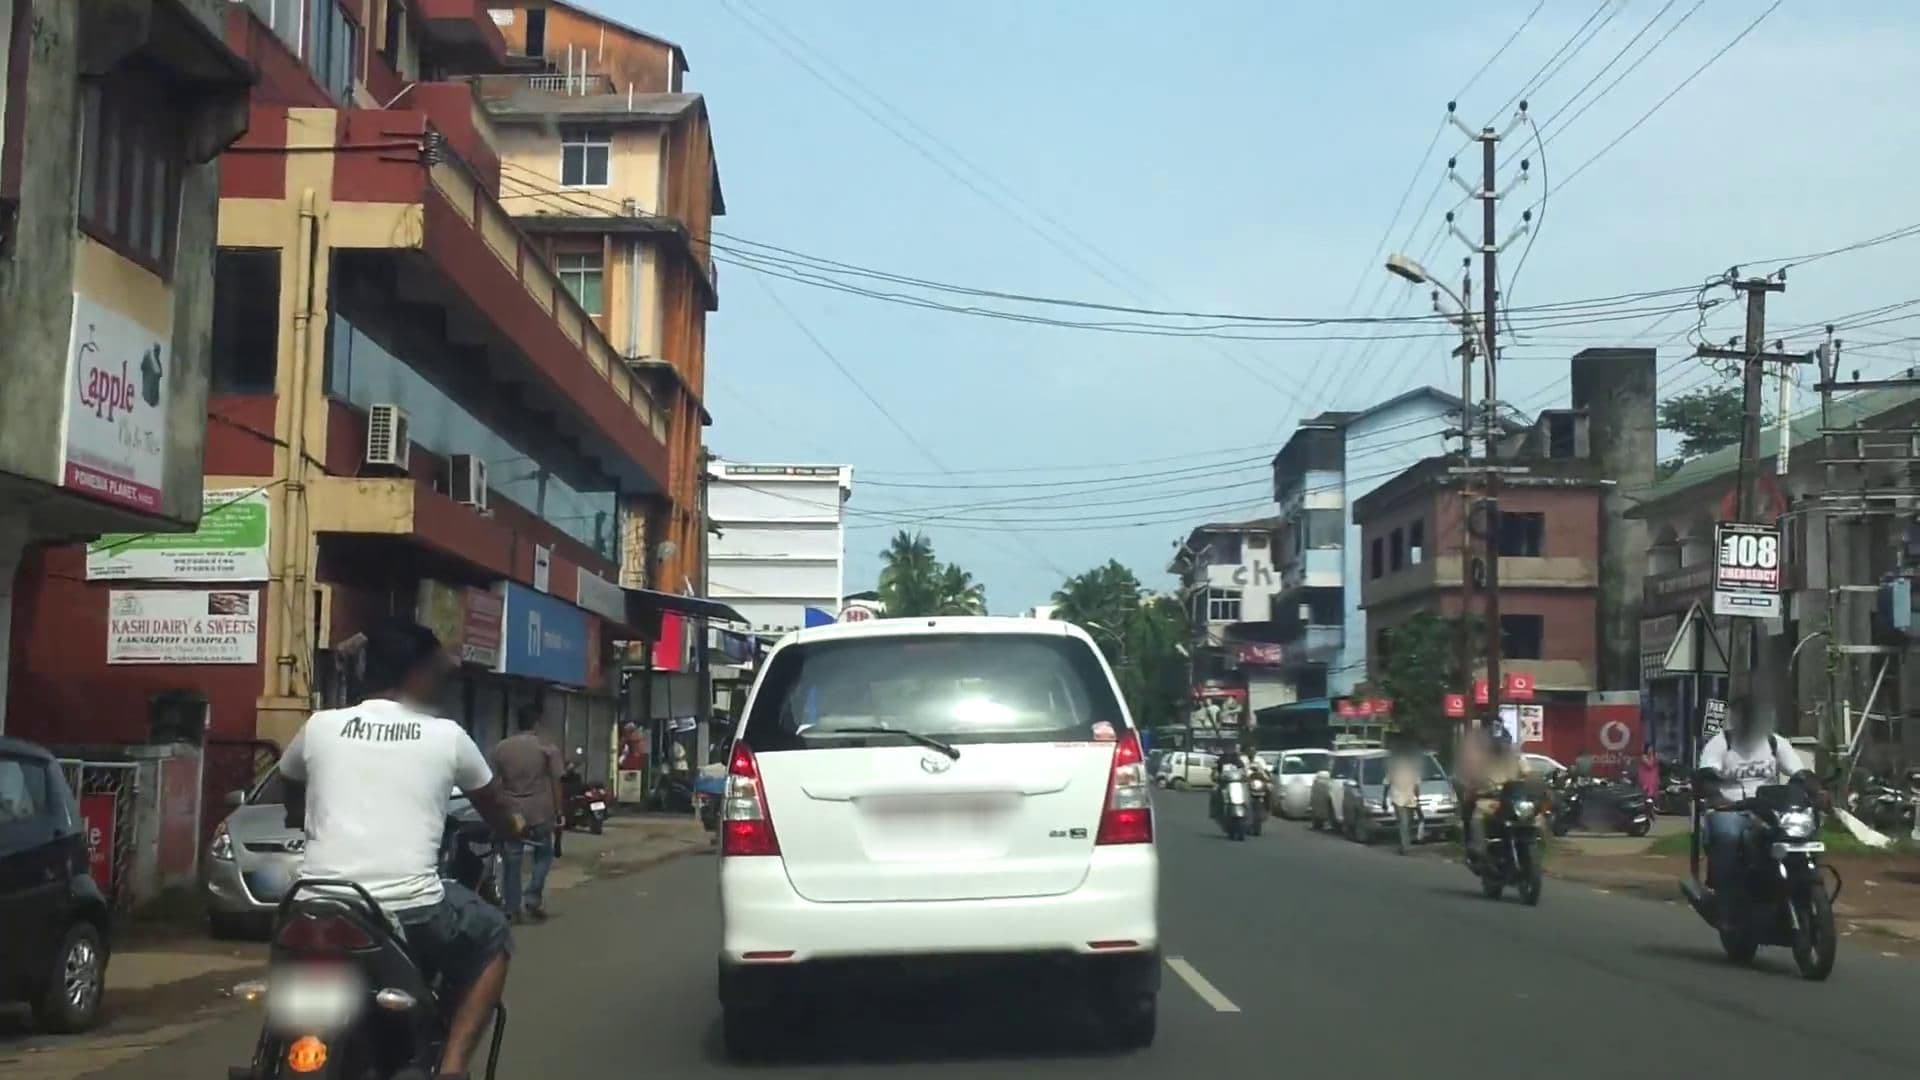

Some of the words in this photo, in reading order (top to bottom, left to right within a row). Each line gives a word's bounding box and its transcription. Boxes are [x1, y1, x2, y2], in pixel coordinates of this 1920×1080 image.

[88, 360, 135, 422] apple
[1724, 535, 1777, 568] 108
[112, 619, 149, 634] KASHI
[153, 619, 192, 634] DAIRY
[194, 622, 202, 635] &
[207, 619, 256, 634] SWEETS
[340, 716, 422, 742] ANYTHING
